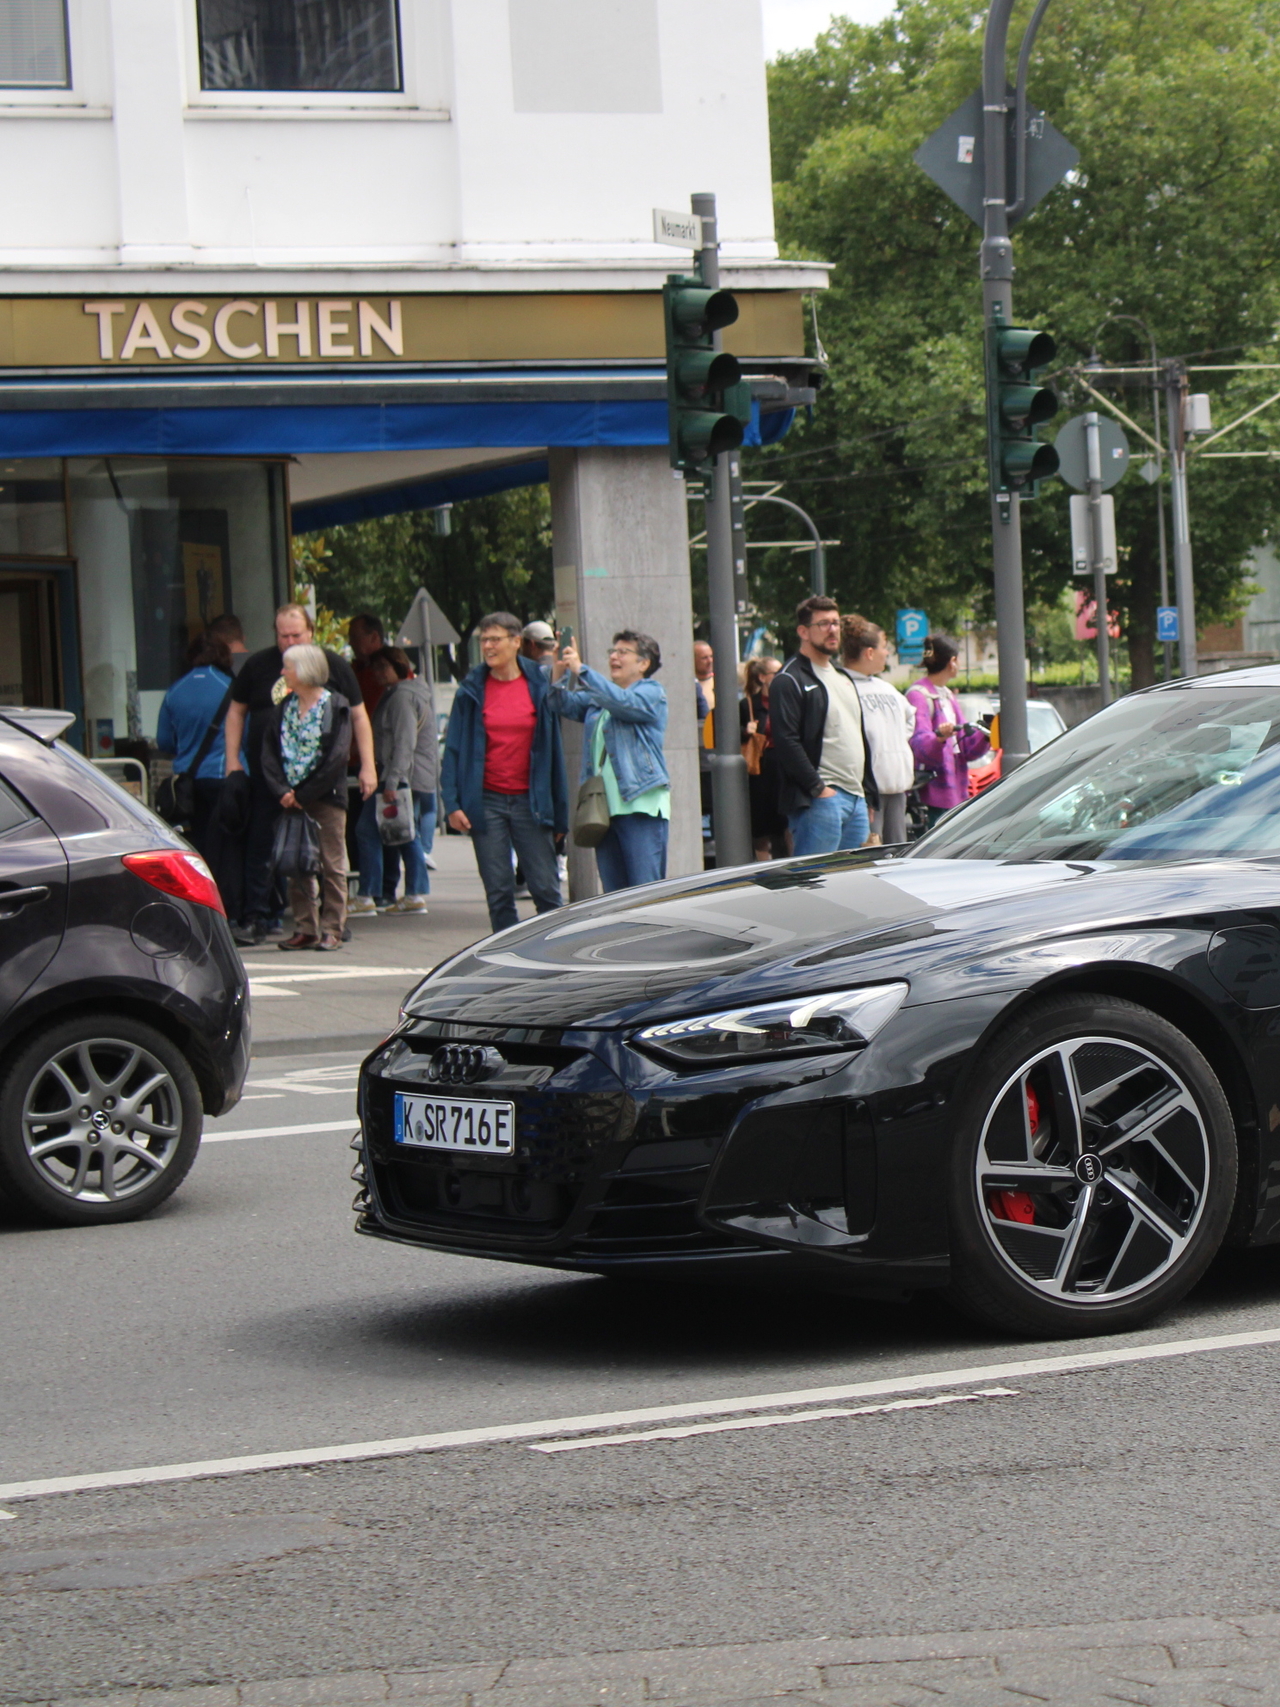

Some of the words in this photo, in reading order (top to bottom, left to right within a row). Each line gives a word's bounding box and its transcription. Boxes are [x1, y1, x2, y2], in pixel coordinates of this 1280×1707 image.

[661, 214, 697, 241] Neumarkt
[83, 300, 404, 360] TASCHEN
[403, 1101, 414, 1139] K
